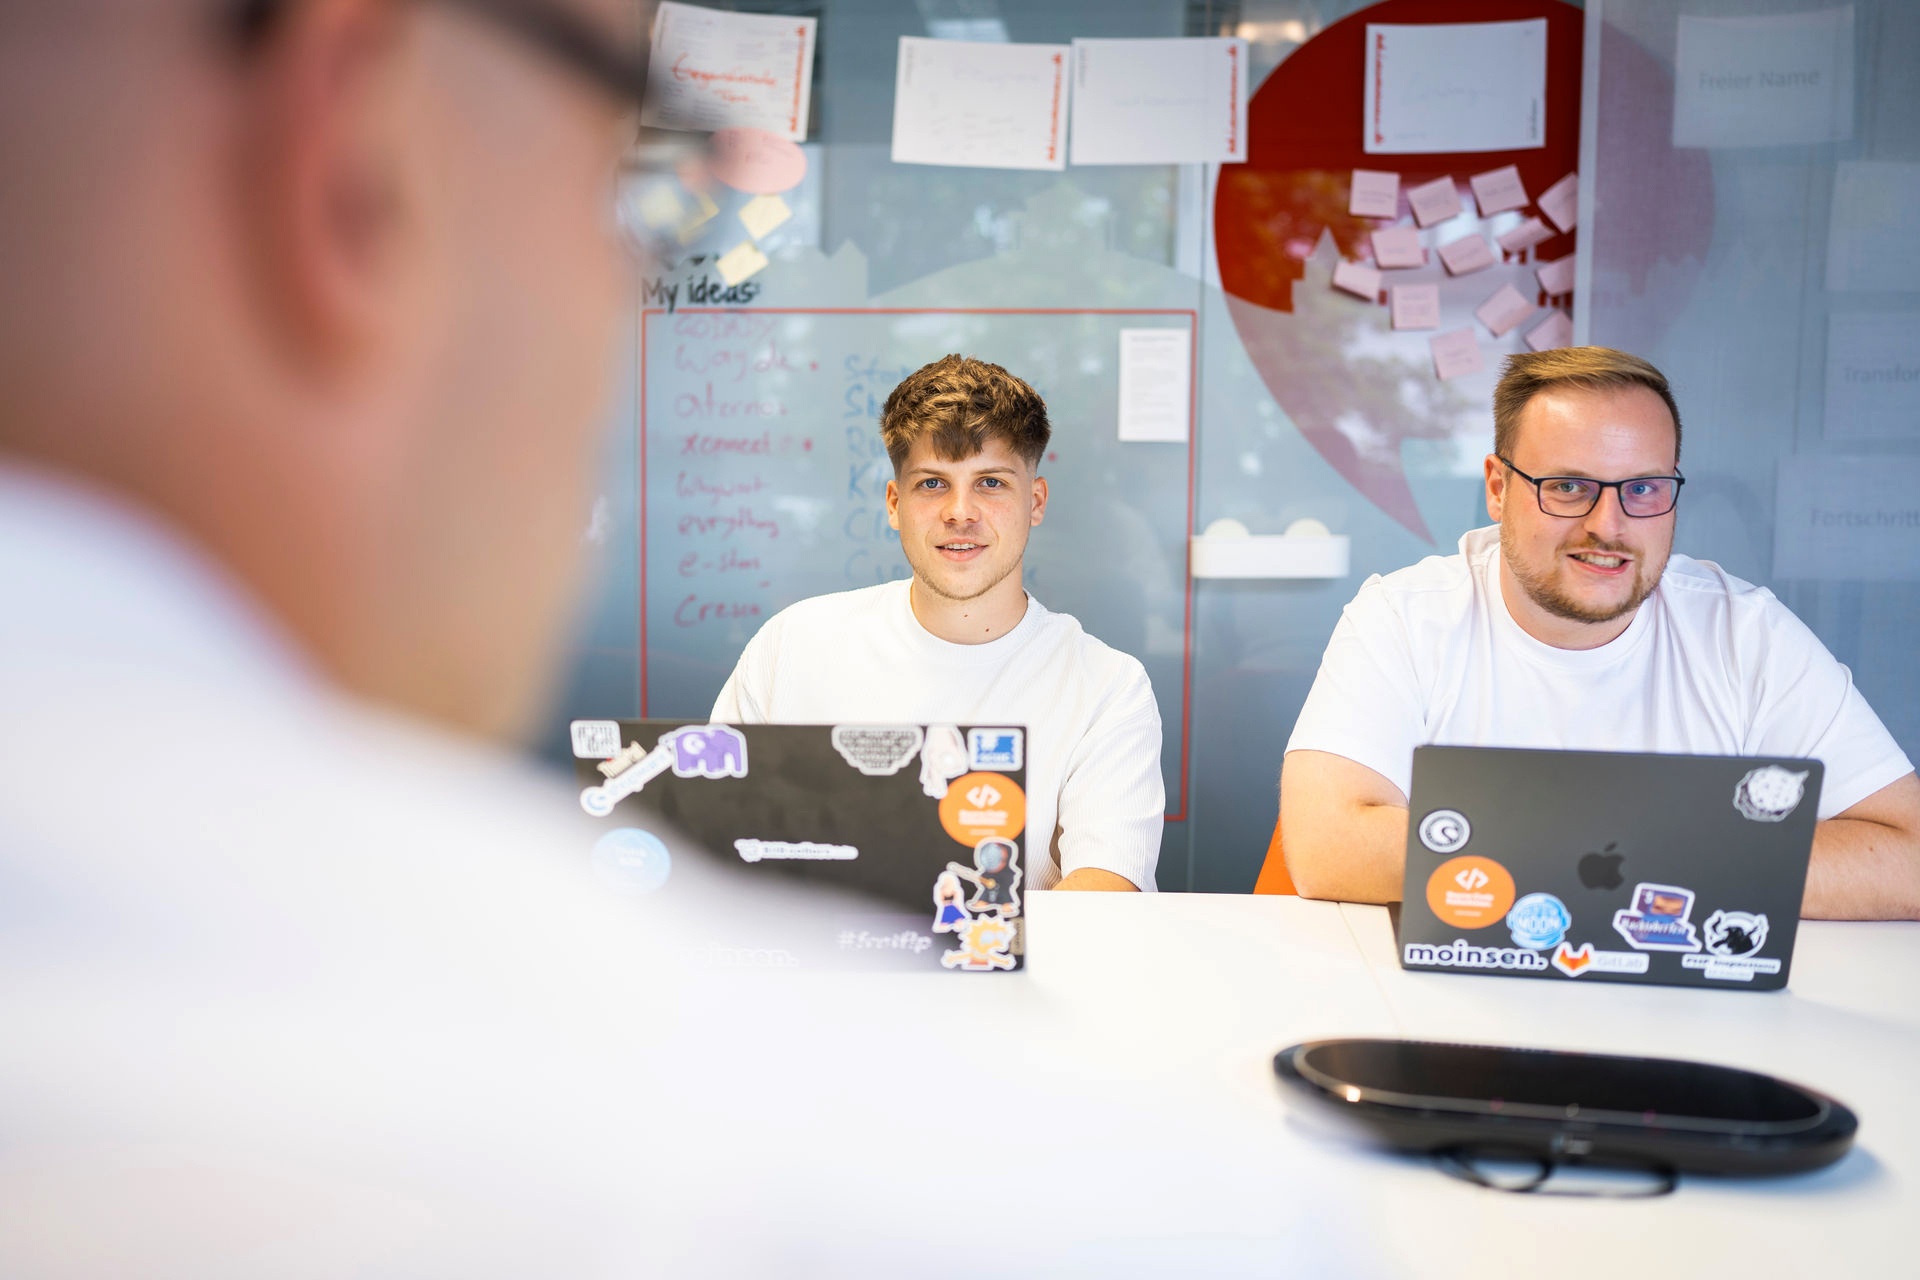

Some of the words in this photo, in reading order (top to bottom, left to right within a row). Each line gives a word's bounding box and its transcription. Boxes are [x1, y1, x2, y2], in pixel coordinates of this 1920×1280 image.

[1699, 72, 1752, 89] Freier
[1759, 69, 1821, 88] Name
[642, 276, 678, 314] My
[1409, 943, 1543, 965] moinsen.
